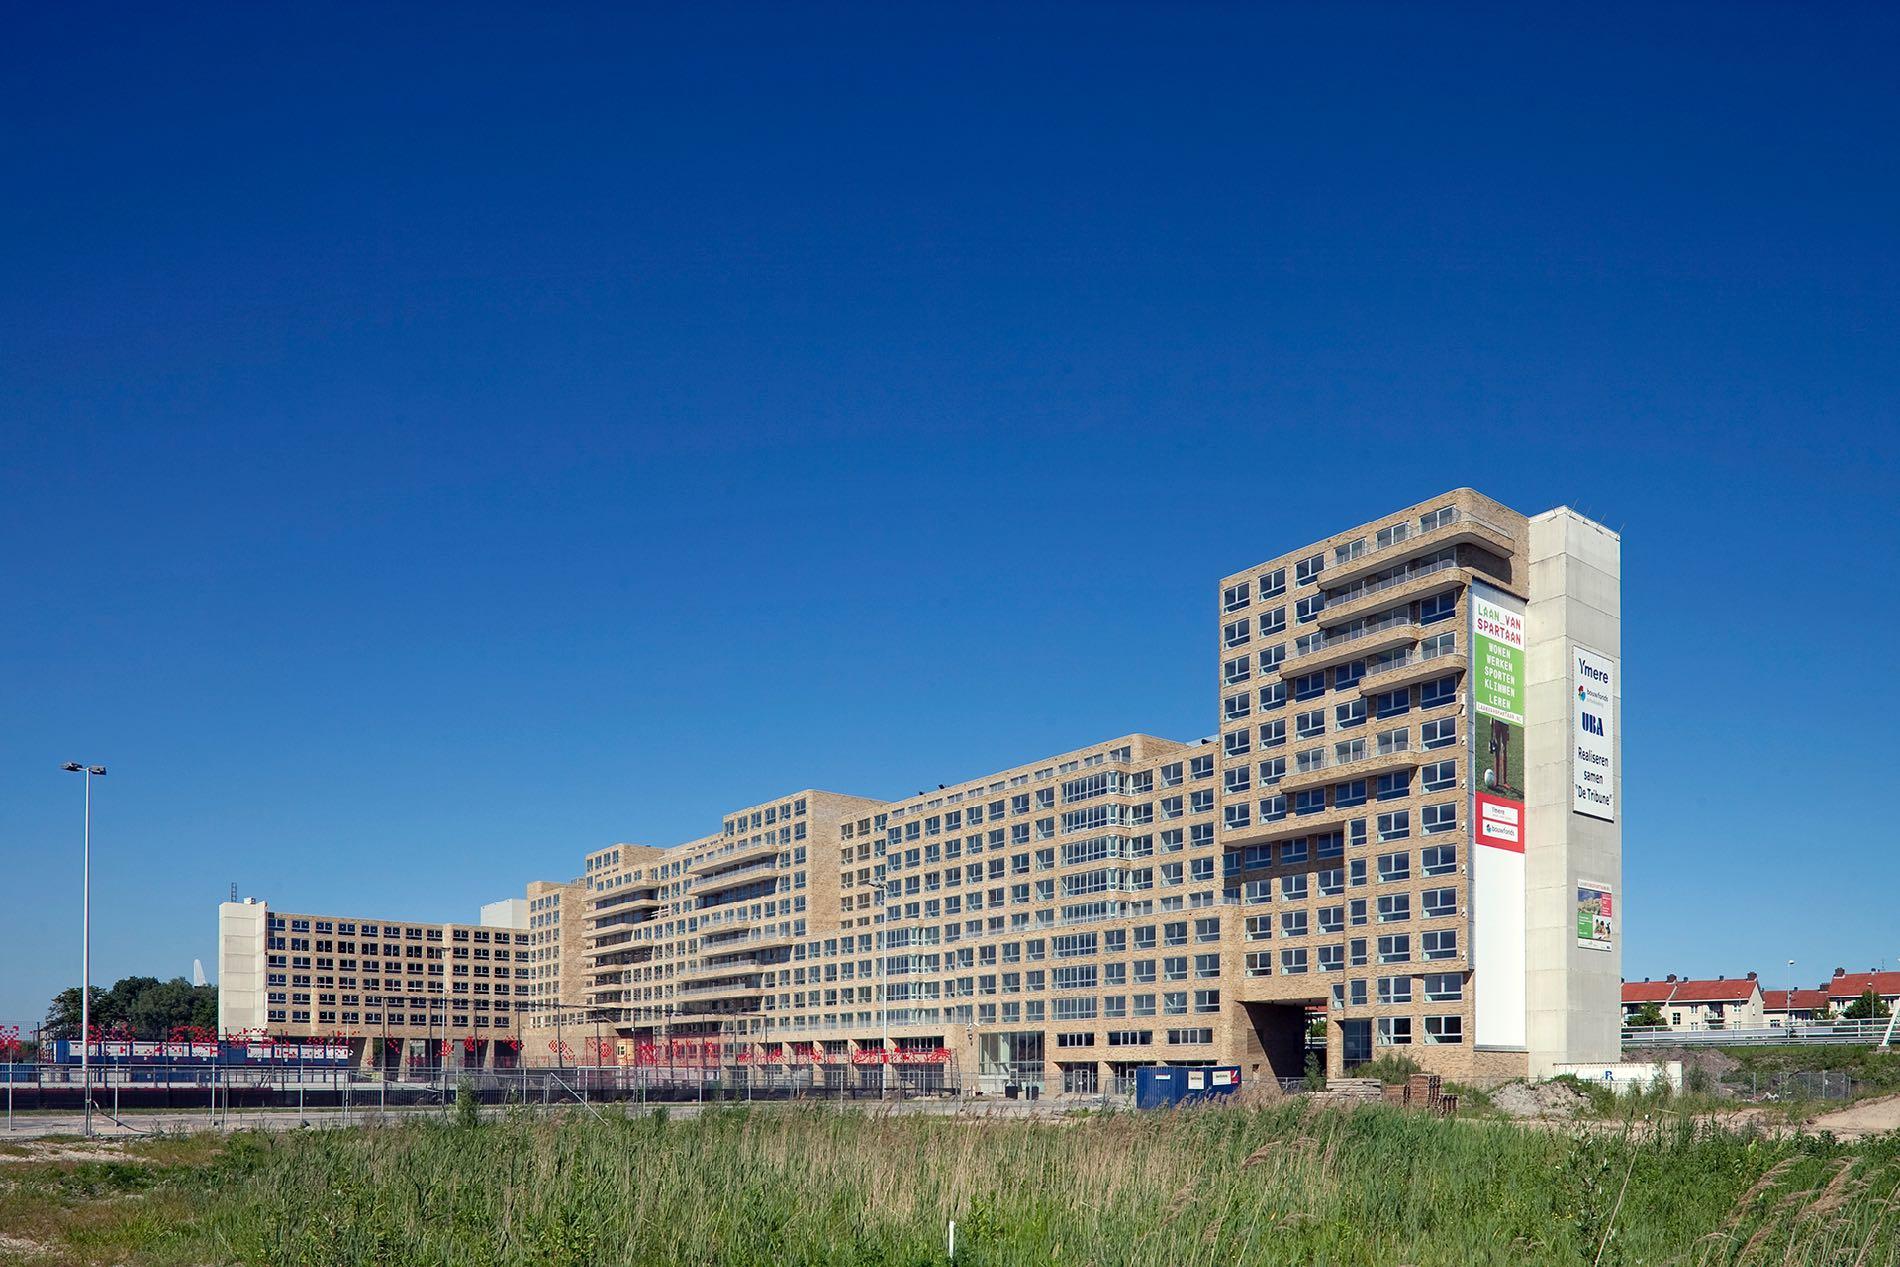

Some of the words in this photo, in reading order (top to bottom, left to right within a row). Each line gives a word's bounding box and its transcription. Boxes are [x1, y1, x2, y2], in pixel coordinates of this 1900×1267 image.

[1477, 618, 1520, 645] SPARTAAN
[1488, 642, 1510, 659] WONEN
[1486, 654, 1512, 672] WERKEN
[1578, 658, 1608, 684] Ymere
[1484, 666, 1515, 685] SPORTEN
[1484, 678, 1515, 698] KLIMMEN
[1489, 694, 1510, 710] LEREN
[1582, 712, 1604, 736] UBA
[1578, 746, 1609, 768] Realiseren
[1584, 770, 1604, 784] samen
[1492, 825, 1514, 836] bouwfonds
